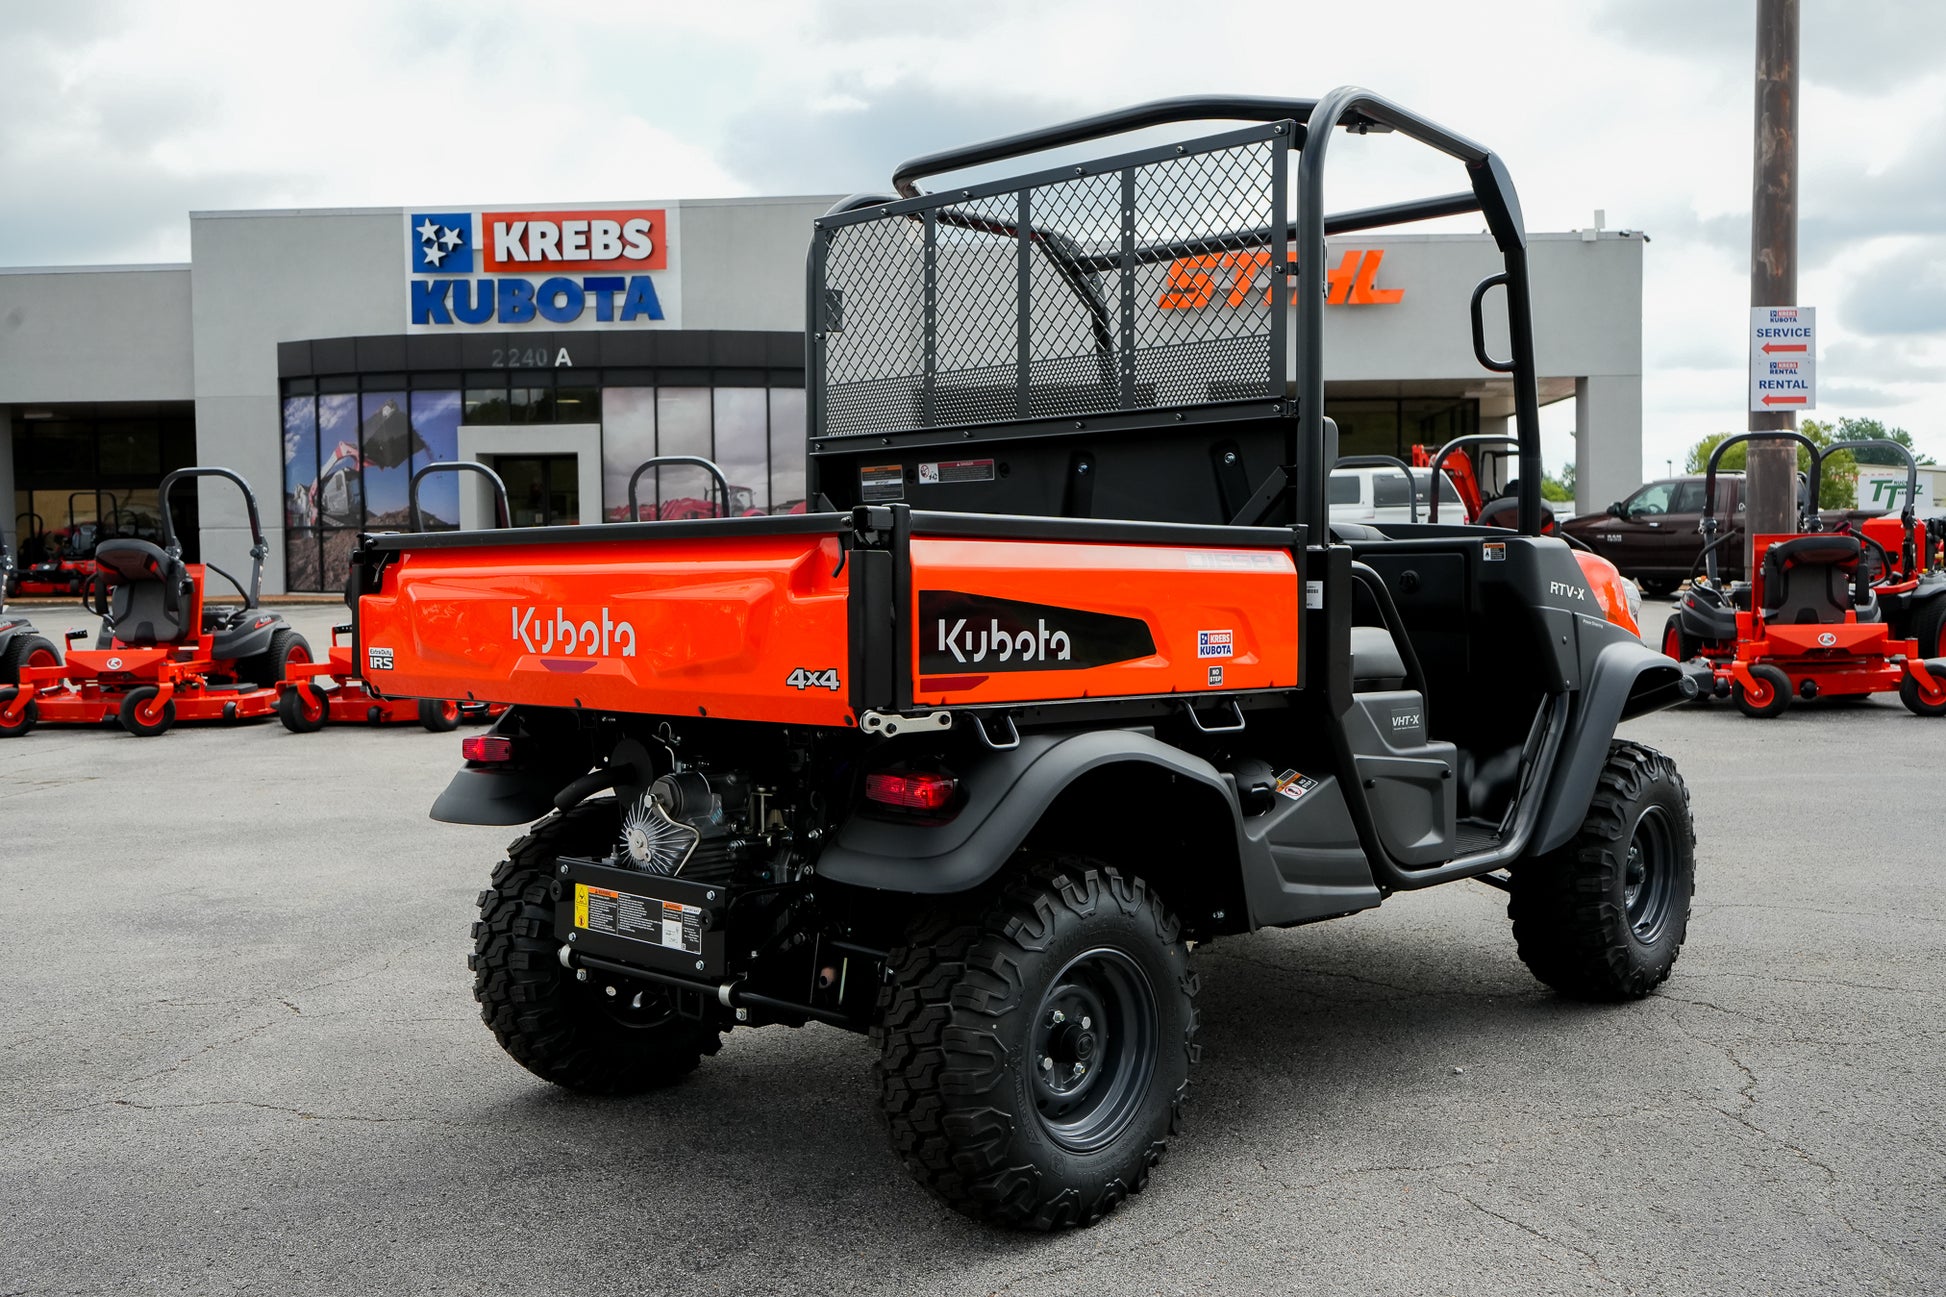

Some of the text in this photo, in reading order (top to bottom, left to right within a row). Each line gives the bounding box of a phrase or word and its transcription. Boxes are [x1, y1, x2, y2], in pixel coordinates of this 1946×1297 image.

[494, 219, 653, 262] KREBS
[411, 275, 665, 324] KUBOTA
[1757, 328, 1811, 338] SERVICE
[492, 347, 573, 368] 2240 A
[1760, 380, 1808, 389] RENTAL
[1550, 581, 1585, 600] RTV-X
[512, 607, 636, 656] Kubota
[938, 619, 1071, 663] Kubota
[1210, 634, 1230, 643] KREBS
[1200, 645, 1231, 655] KUBOTA
[370, 657, 393, 669] IRS
[786, 668, 840, 691] 4x4
